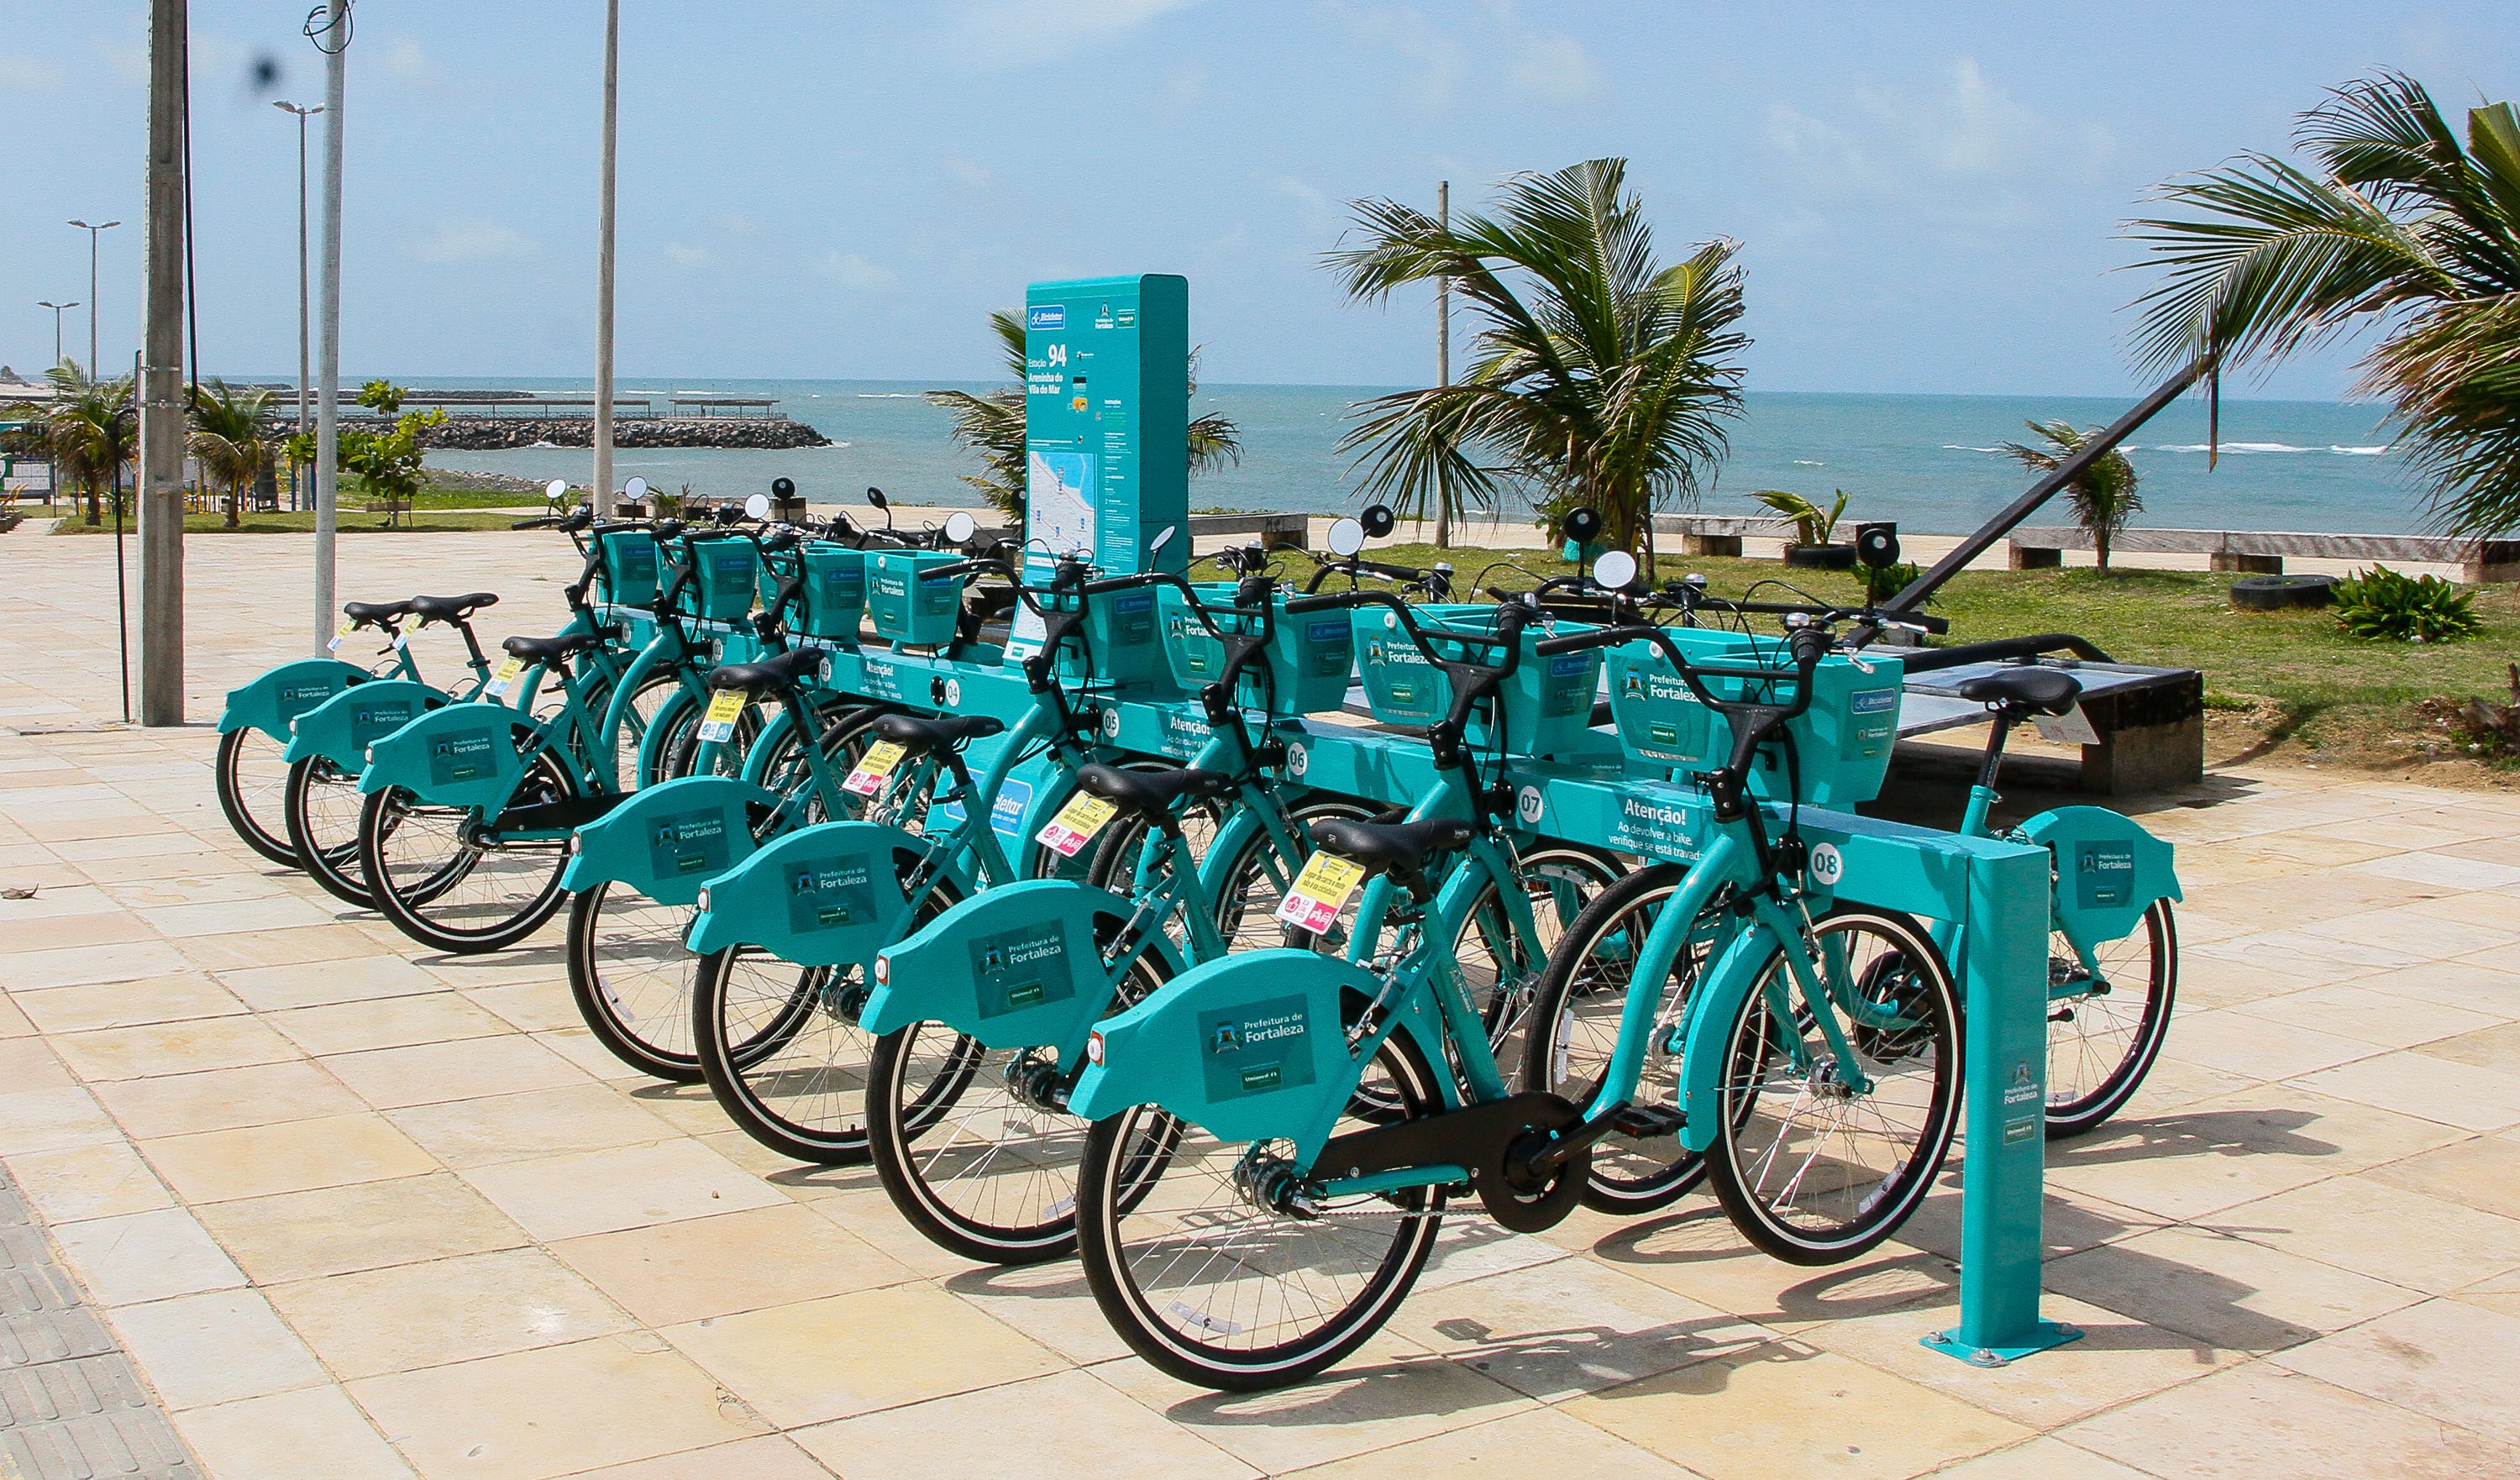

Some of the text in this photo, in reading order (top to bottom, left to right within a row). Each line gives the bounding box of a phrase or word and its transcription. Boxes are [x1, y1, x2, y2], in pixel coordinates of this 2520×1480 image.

[1048, 344, 1067, 367] 94
[1028, 359, 1047, 369] Estação
[1028, 372, 1063, 382] Areninha do
[1028, 385, 1061, 394] Vila do Mar
[880, 584, 905, 596] Fortaleza
[821, 663, 829, 675] 03
[866, 660, 894, 678] Atenção!
[948, 685, 958, 699] 04
[1105, 715, 1117, 730] 05
[454, 743, 490, 753] Fortaleza
[1289, 749, 1305, 769] 06
[1521, 794, 1540, 814] 07
[1625, 798, 1687, 826] Atenção!
[680, 827, 722, 840] Fortaleza
[1617, 821, 1630, 832] Ao
[1630, 823, 1665, 841] devolver
[1666, 832, 1672, 842] a
[1609, 835, 1705, 861] verifique se está travad
[1814, 852, 1837, 875] 08
[2098, 860, 2132, 869] Fortaleza
[819, 869, 855, 879] Prefeitura
[820, 876, 867, 889] Fortaleza
[1008, 935, 1059, 953] Prefeitura de
[1010, 945, 1062, 964] Fortaleza
[1244, 1012, 1303, 1030] Prefeitura de
[1245, 1024, 1305, 1042] Fortaleza
[1245, 1073, 1269, 1082] Unimed
[2003, 1091, 2038, 1105] Fortaleza
